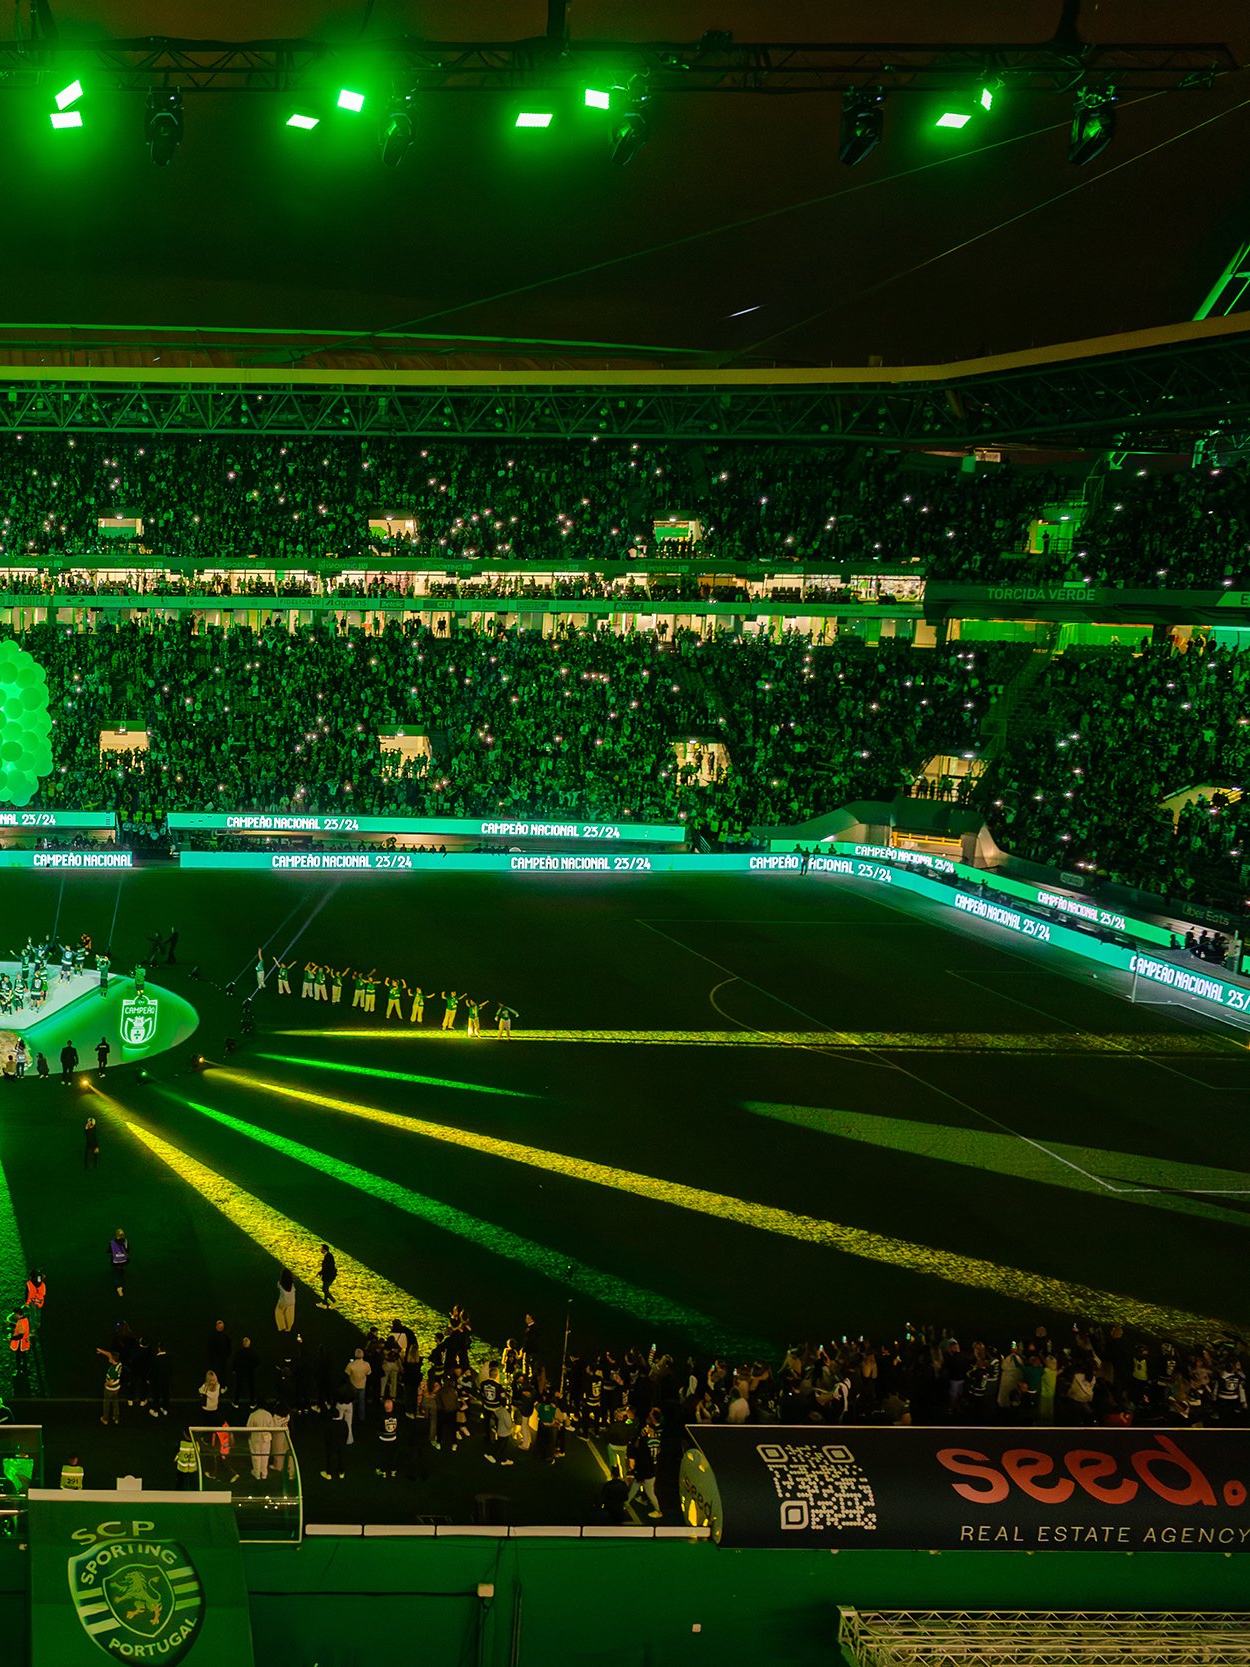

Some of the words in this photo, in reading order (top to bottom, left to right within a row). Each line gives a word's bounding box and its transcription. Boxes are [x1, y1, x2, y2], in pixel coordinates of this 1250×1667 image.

[988, 588, 1046, 600] TORCIDA
[1049, 589, 1095, 600] VERDE
[21, 813, 56, 825] 23/24
[227, 815, 272, 829] CAMPEÃO
[273, 817, 320, 830] NACIONAL
[324, 819, 358, 830] 23/24
[481, 822, 529, 835] CAMPEÃO
[530, 824, 579, 836] NACIONAL
[583, 826, 620, 838] 23/24
[33, 852, 82, 867] CAMPEÃO
[83, 854, 133, 867] NACIONAL
[272, 853, 320, 868] CAMPEÃO
[322, 855, 372, 868] NACIONAL
[375, 855, 412, 868] 23/24
[511, 855, 559, 869] CAMPEÃO
[560, 857, 610, 869] NACIONAL
[613, 857, 651, 870] 23/24
[750, 854, 798, 868] CAMPEÃO
[801, 857, 855, 874] ACIONAL
[858, 864, 892, 882] 23/24
[855, 845, 897, 860] CAMPEÃO
[898, 850, 934, 868] NACIONAL
[935, 858, 955, 873] 23/24
[955, 893, 987, 918] CAMPEÃO
[986, 904, 1021, 930] NACIONAL
[1023, 918, 1050, 941] 23/24
[1067, 900, 1099, 922] NACIONAL
[1100, 911, 1126, 931] 23/24
[1129, 955, 1175, 984] CAMPEÃO
[1174, 970, 1224, 1003] NACIONAL
[936, 1434, 1248, 1507] seed.
[71, 1521, 156, 1546] SCP
[960, 1525, 1025, 1542] REAL
[1037, 1526, 1131, 1543] ESTATE
[1143, 1527, 1250, 1544] AGENCY
[80, 1543, 177, 1585] SPORTING
[109, 1616, 198, 1657] PORTUGAL
